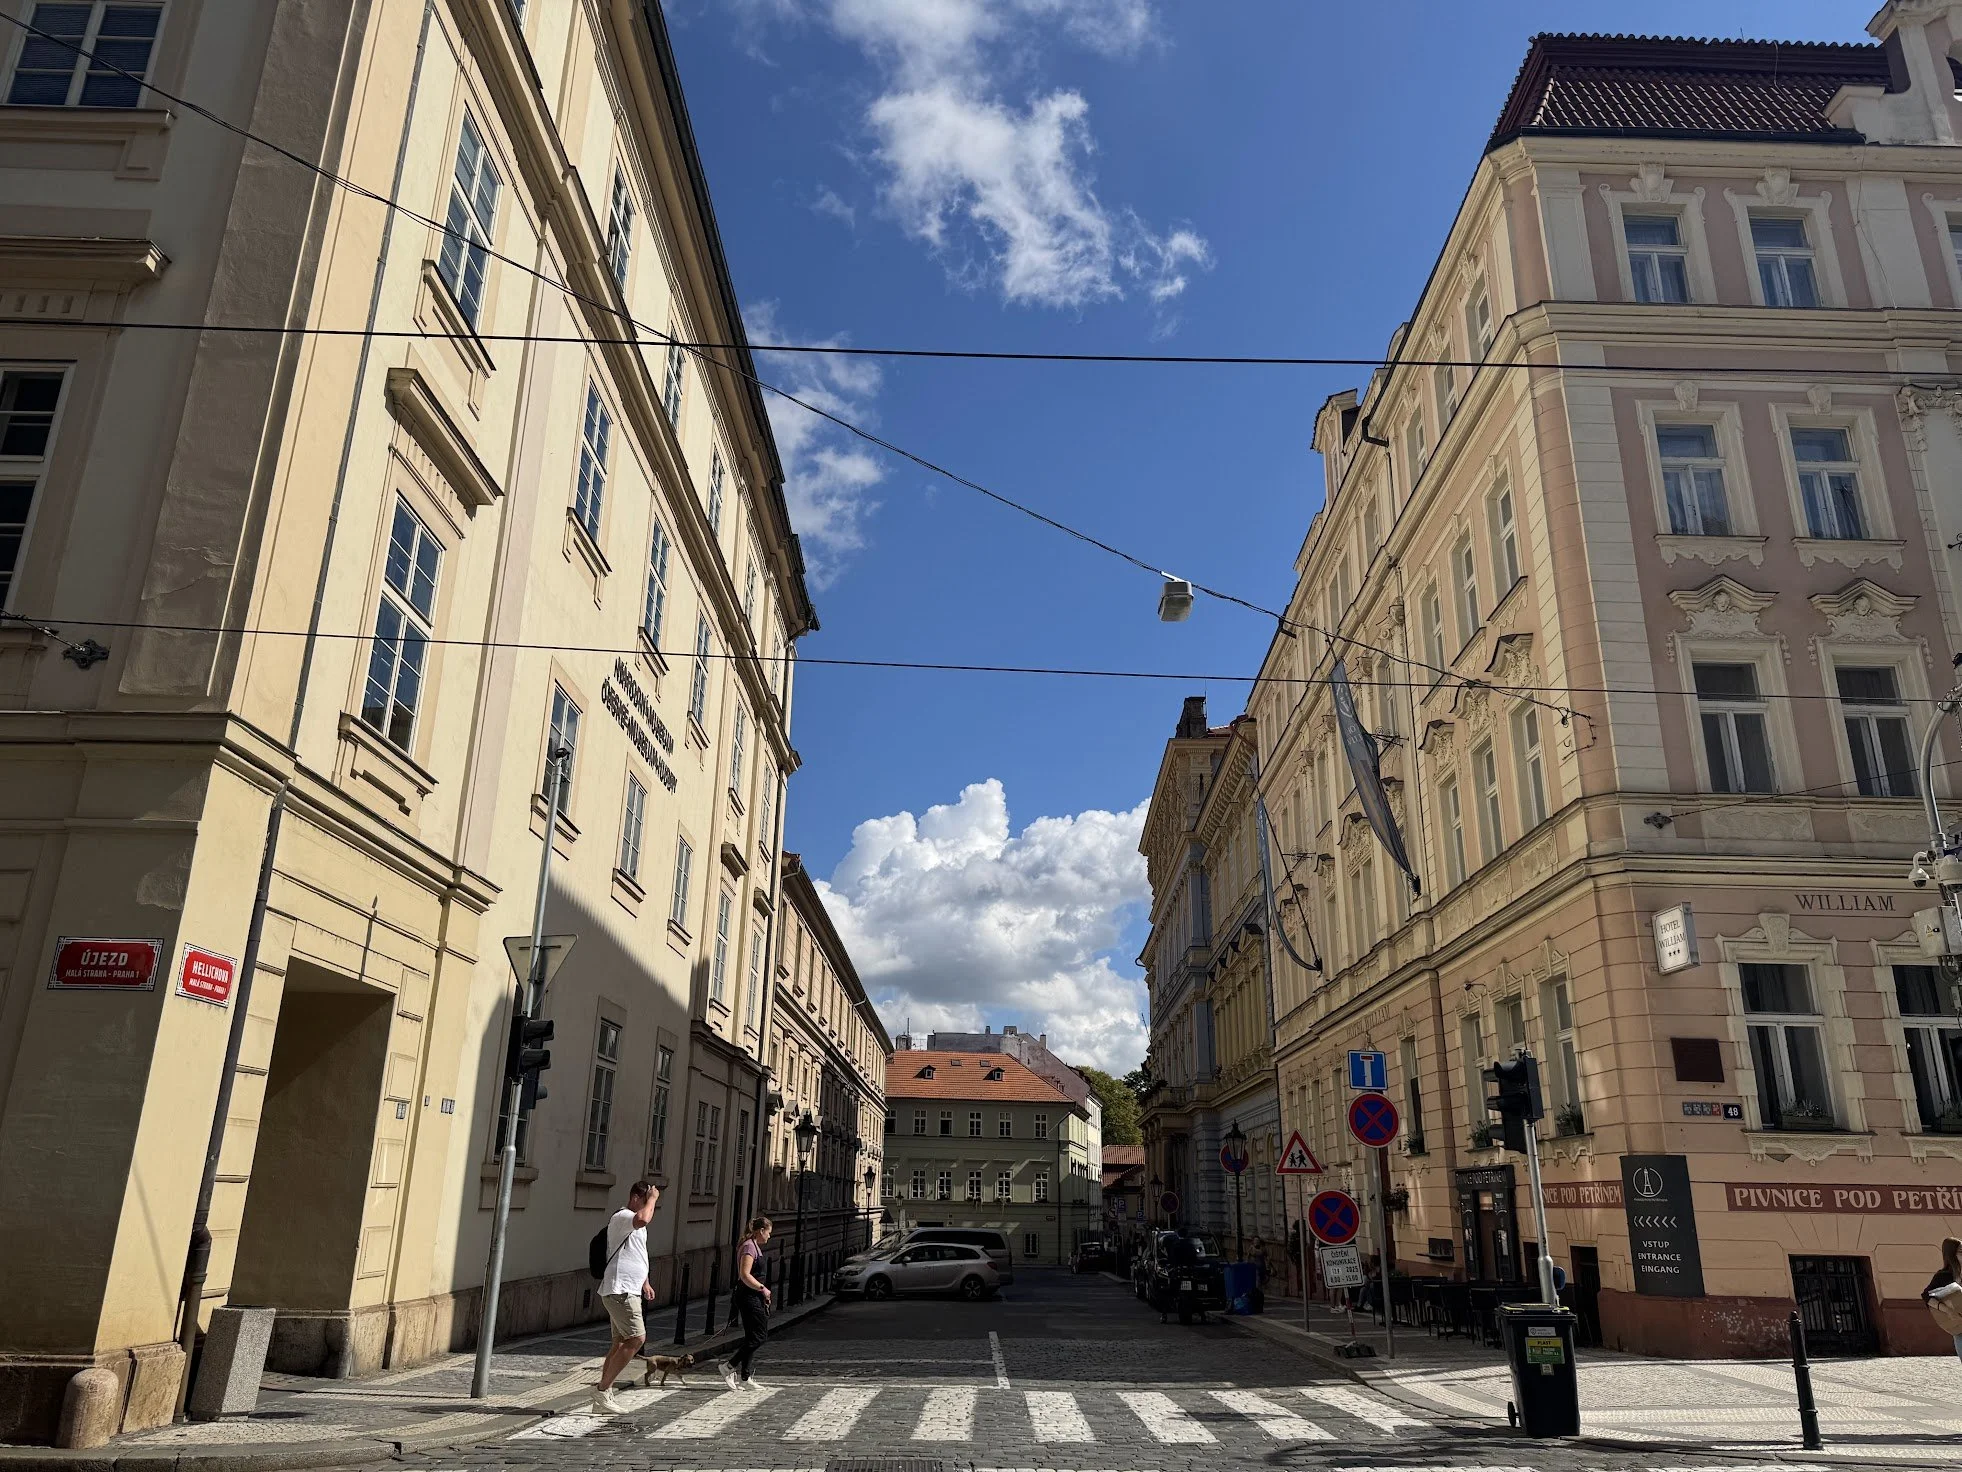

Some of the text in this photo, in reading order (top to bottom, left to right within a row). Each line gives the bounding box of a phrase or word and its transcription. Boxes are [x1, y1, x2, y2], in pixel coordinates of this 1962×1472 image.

[1794, 894, 1897, 911] WILLIAM
[1660, 919, 1680, 934] HOTEL
[1658, 932, 1686, 949] WILLIAM
[80, 949, 129, 966] ÚJEZD
[65, 968, 82, 977] MALÁ
[82, 969, 107, 978] STRANA
[112, 970, 135, 978] PRAHA
[135, 971, 140, 979] 1
[192, 960, 229, 984] HELLICHOVA
[188, 977, 201, 987] MALÁ
[1727, 1107, 1739, 1117] 48
[1541, 1182, 1622, 1204] NICE POD PETŘÍNEM
[1733, 1186, 1962, 1210] PIVNICE POD PETŘÍ
[1642, 1240, 1670, 1248] VSTUP
[1325, 1258, 1356, 1267] KOMUNIKACE
[1637, 1252, 1682, 1261] ENTRANCE
[1641, 1265, 1680, 1274] EINGANG
